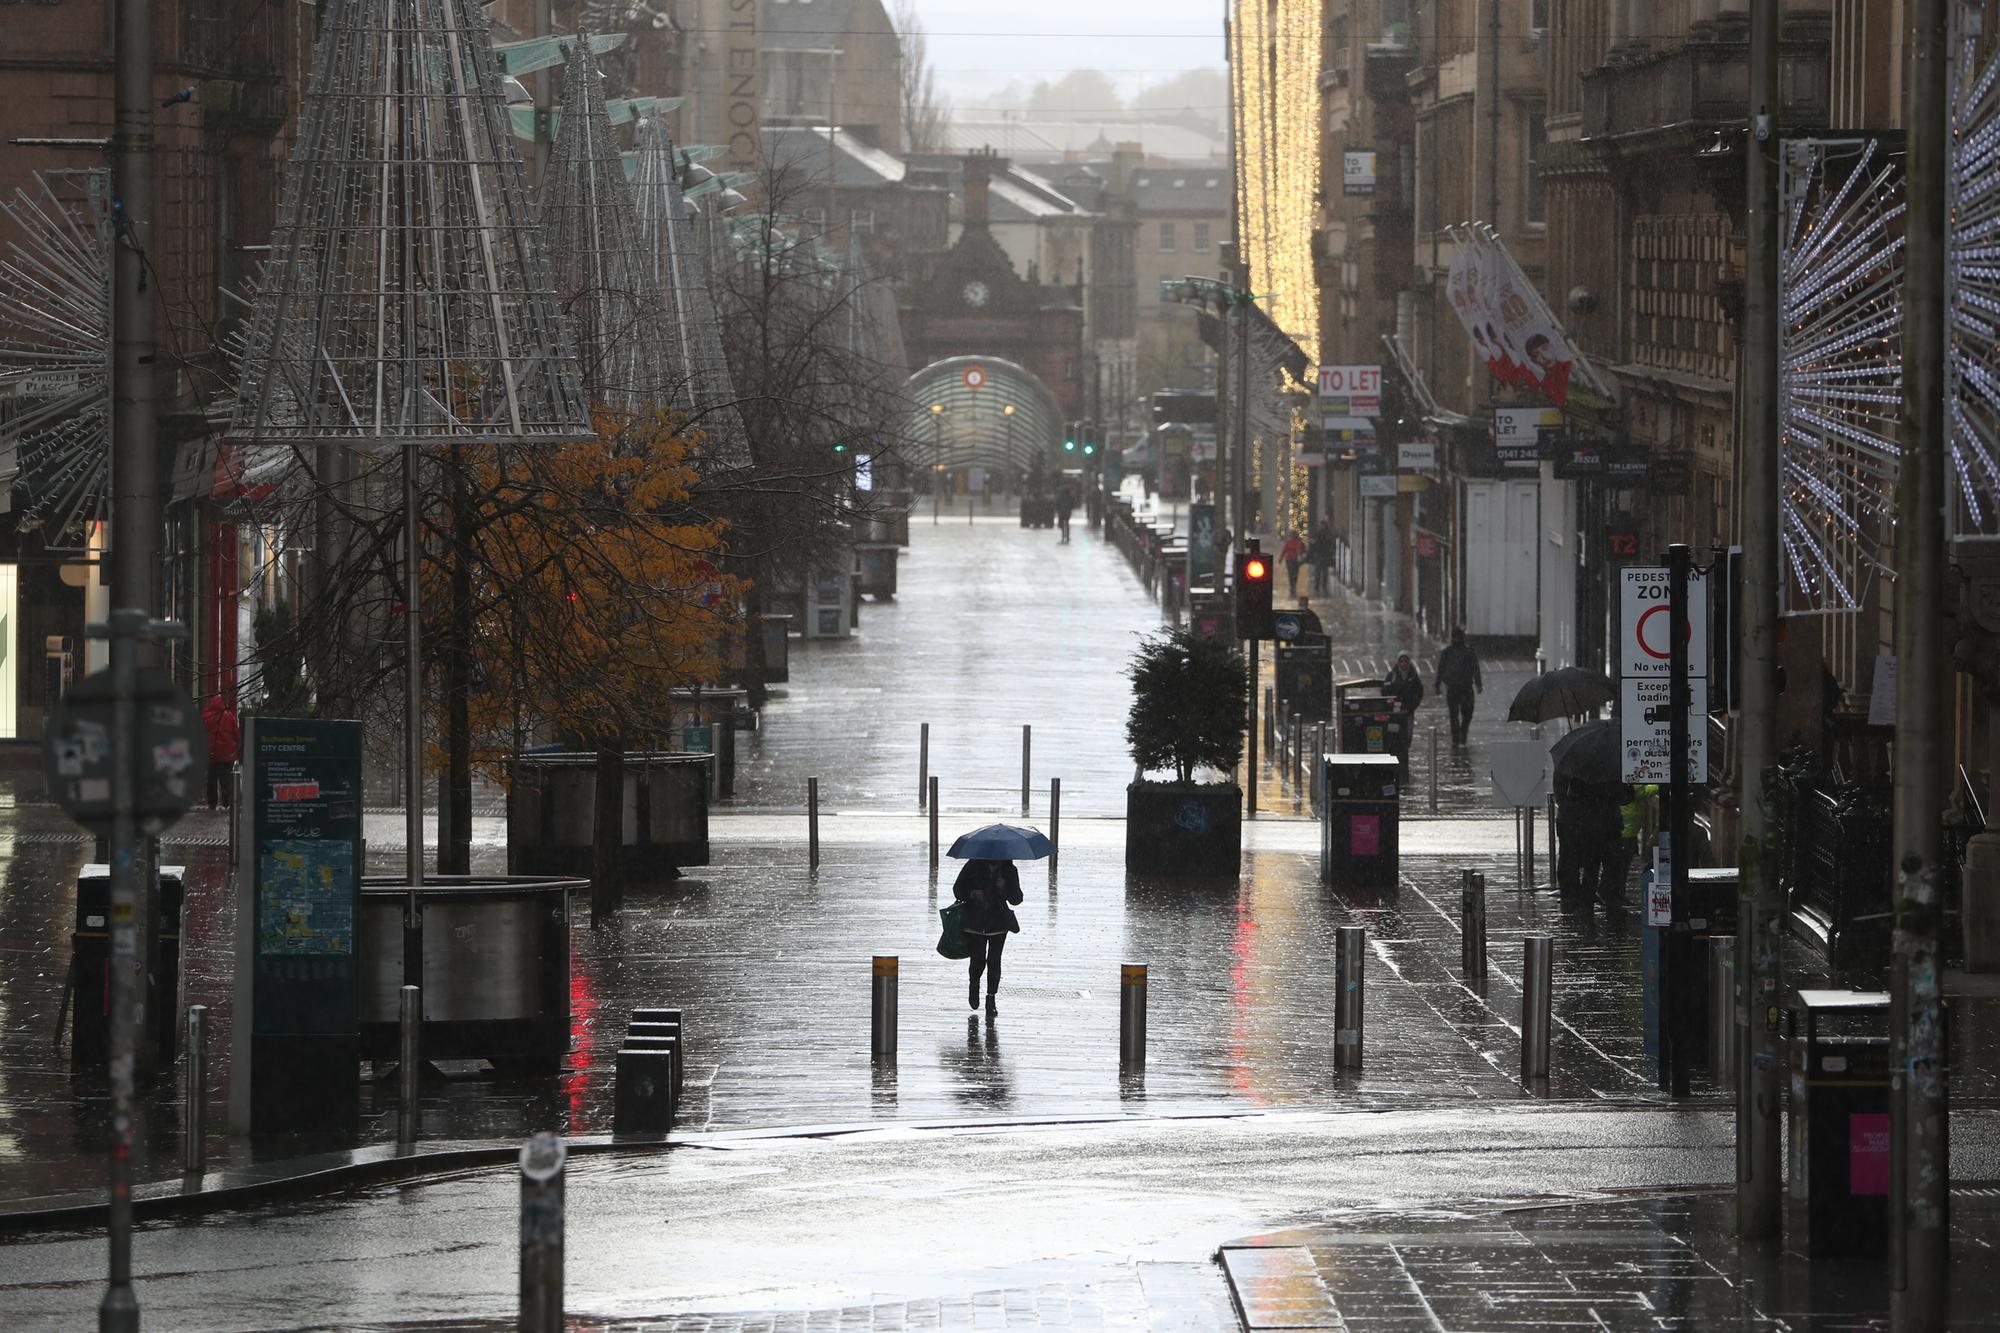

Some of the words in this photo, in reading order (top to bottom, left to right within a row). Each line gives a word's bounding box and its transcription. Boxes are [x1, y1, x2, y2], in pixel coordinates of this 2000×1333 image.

[1320, 371, 1344, 391] TO
[1349, 370, 1379, 391] LET
[1497, 415, 1513, 425] TO
[1497, 425, 1518, 435] LET
[1497, 449, 1518, 459] 0141
[1608, 535, 1638, 555] T2
[1627, 573, 1700, 582] PEDESTN
[1637, 586, 1671, 599] ZON
[1634, 663, 1649, 672] No
[1652, 663, 1695, 672] vehs
[260, 744, 279, 752] CITY
[280, 744, 306, 752] CENTRE
[1626, 738, 1660, 748] permit
[1640, 759, 1662, 768] Mon
